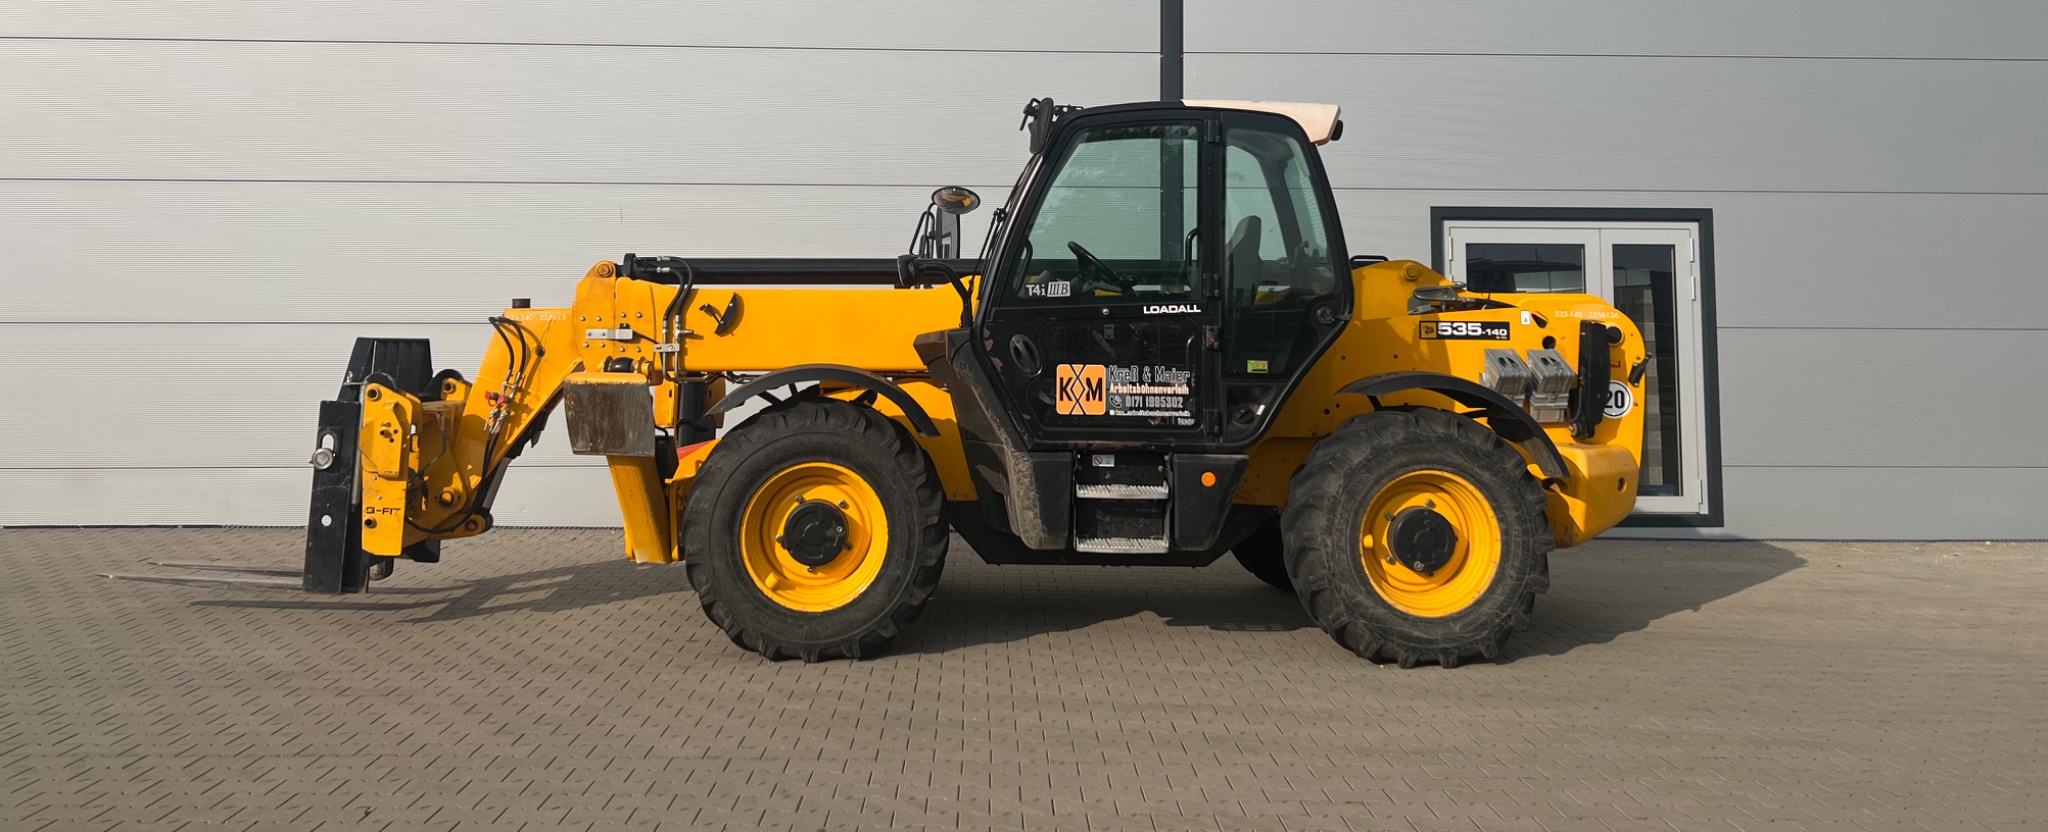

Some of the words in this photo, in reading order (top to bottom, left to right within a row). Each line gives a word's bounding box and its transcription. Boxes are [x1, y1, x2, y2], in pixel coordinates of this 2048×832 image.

[1025, 284, 1046, 296] T4i
[1143, 304, 1201, 314] LOADALL
[1437, 322, 1508, 336] 535-140
[1109, 365, 1139, 381] Kreß
[1142, 366, 1152, 382] &
[1154, 366, 1191, 382] Maier
[1125, 395, 1143, 408] 0171
